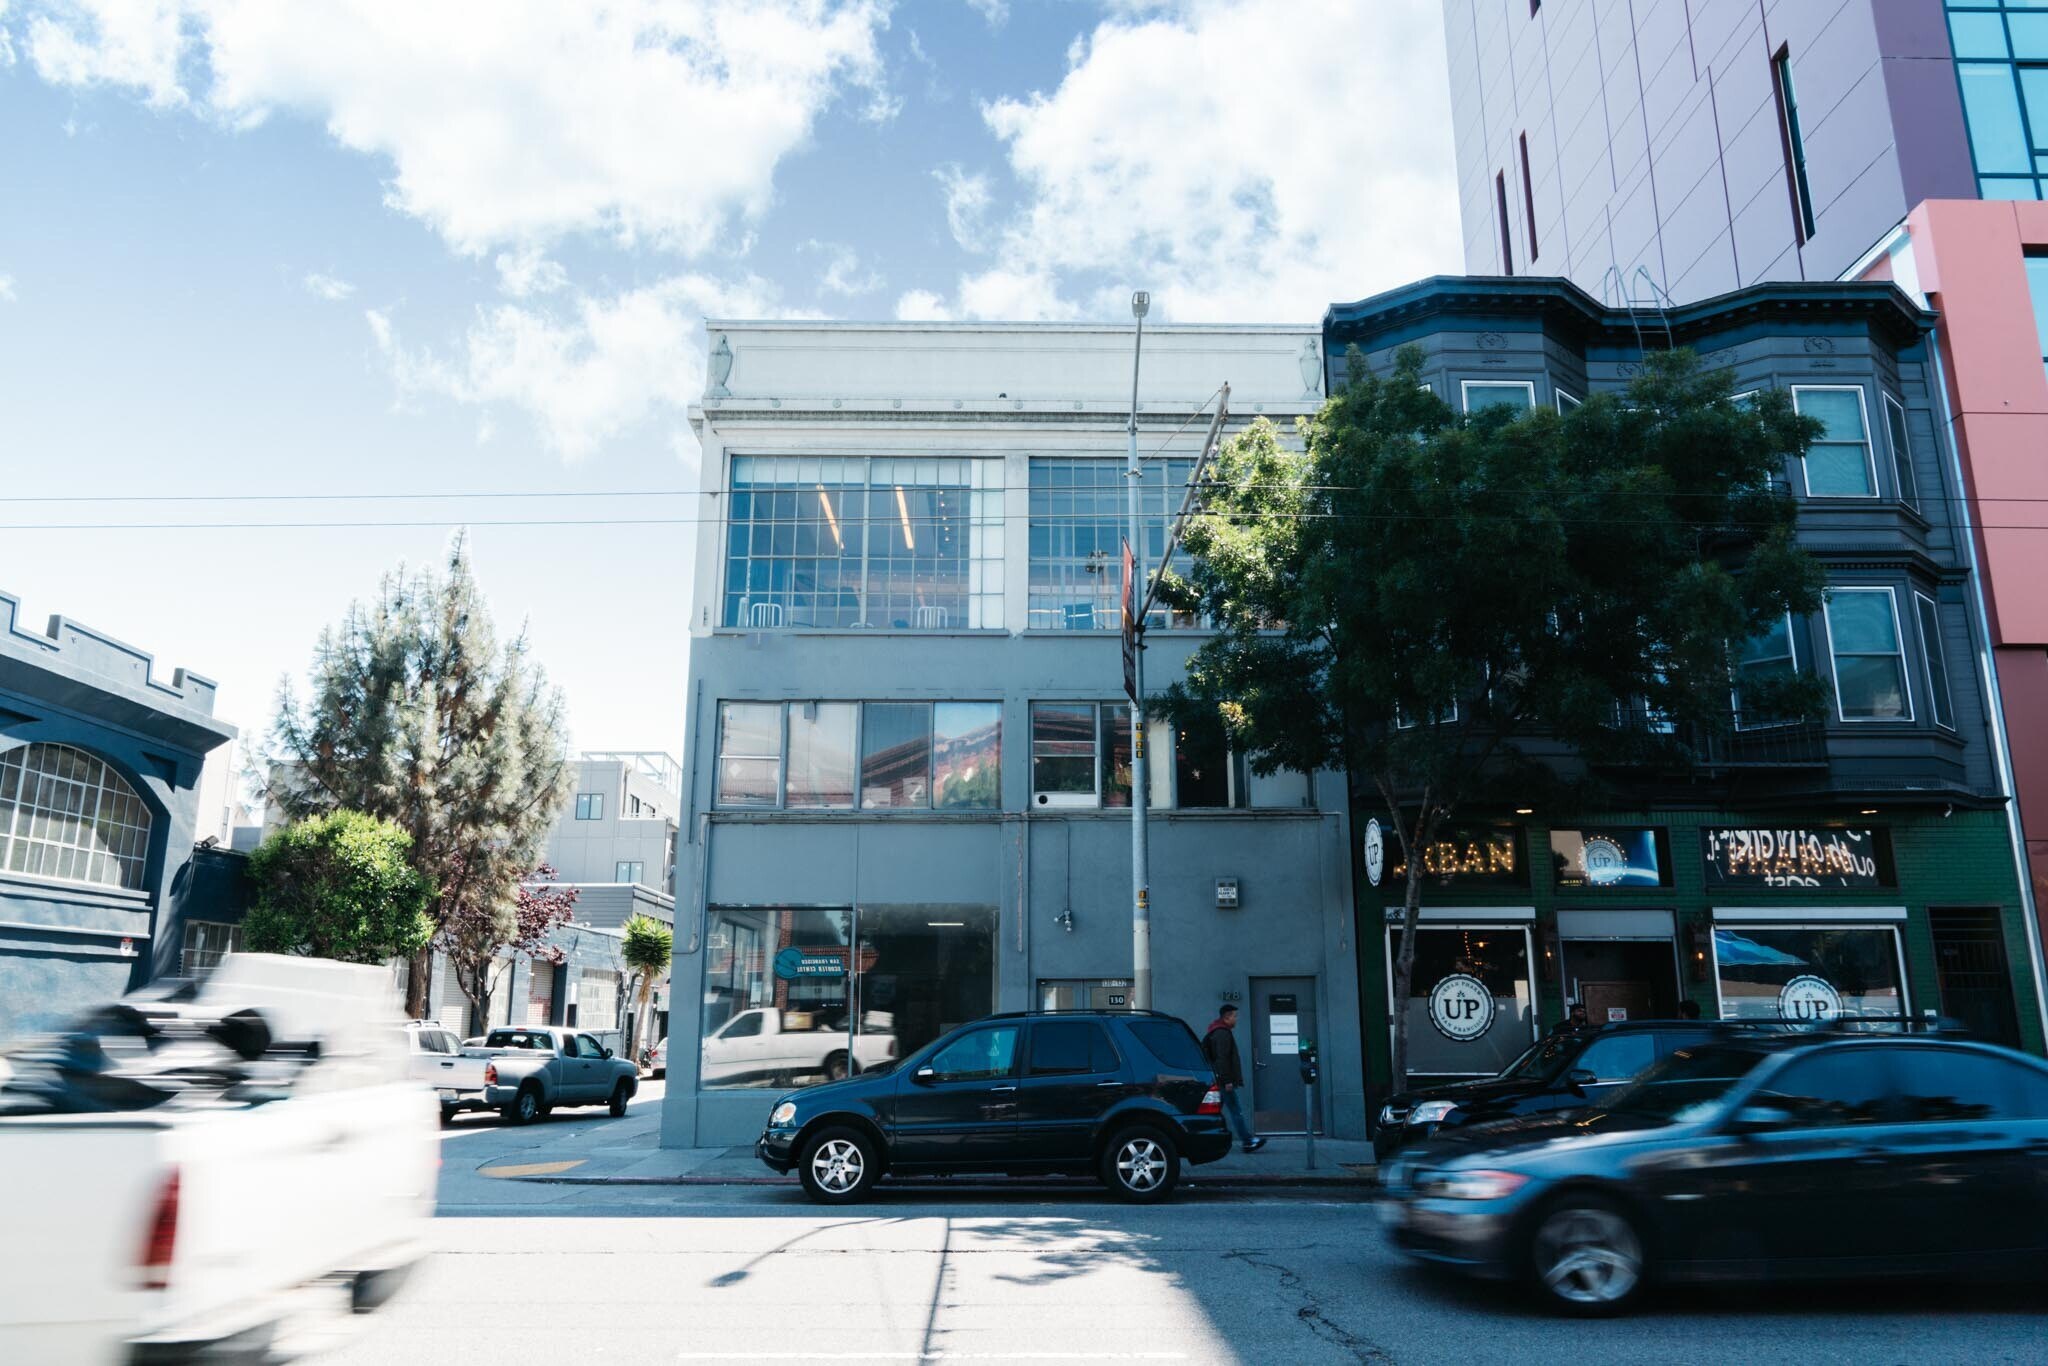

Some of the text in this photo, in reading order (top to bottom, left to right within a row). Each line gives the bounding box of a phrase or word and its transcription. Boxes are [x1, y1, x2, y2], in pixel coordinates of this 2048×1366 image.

[1368, 843, 1379, 866] UP
[1393, 840, 1515, 877] RBAN
[1592, 857, 1611, 868] UP
[1110, 996, 1124, 1004] 130
[1444, 998, 1480, 1020] UP
[1792, 1000, 1829, 1020] UP
